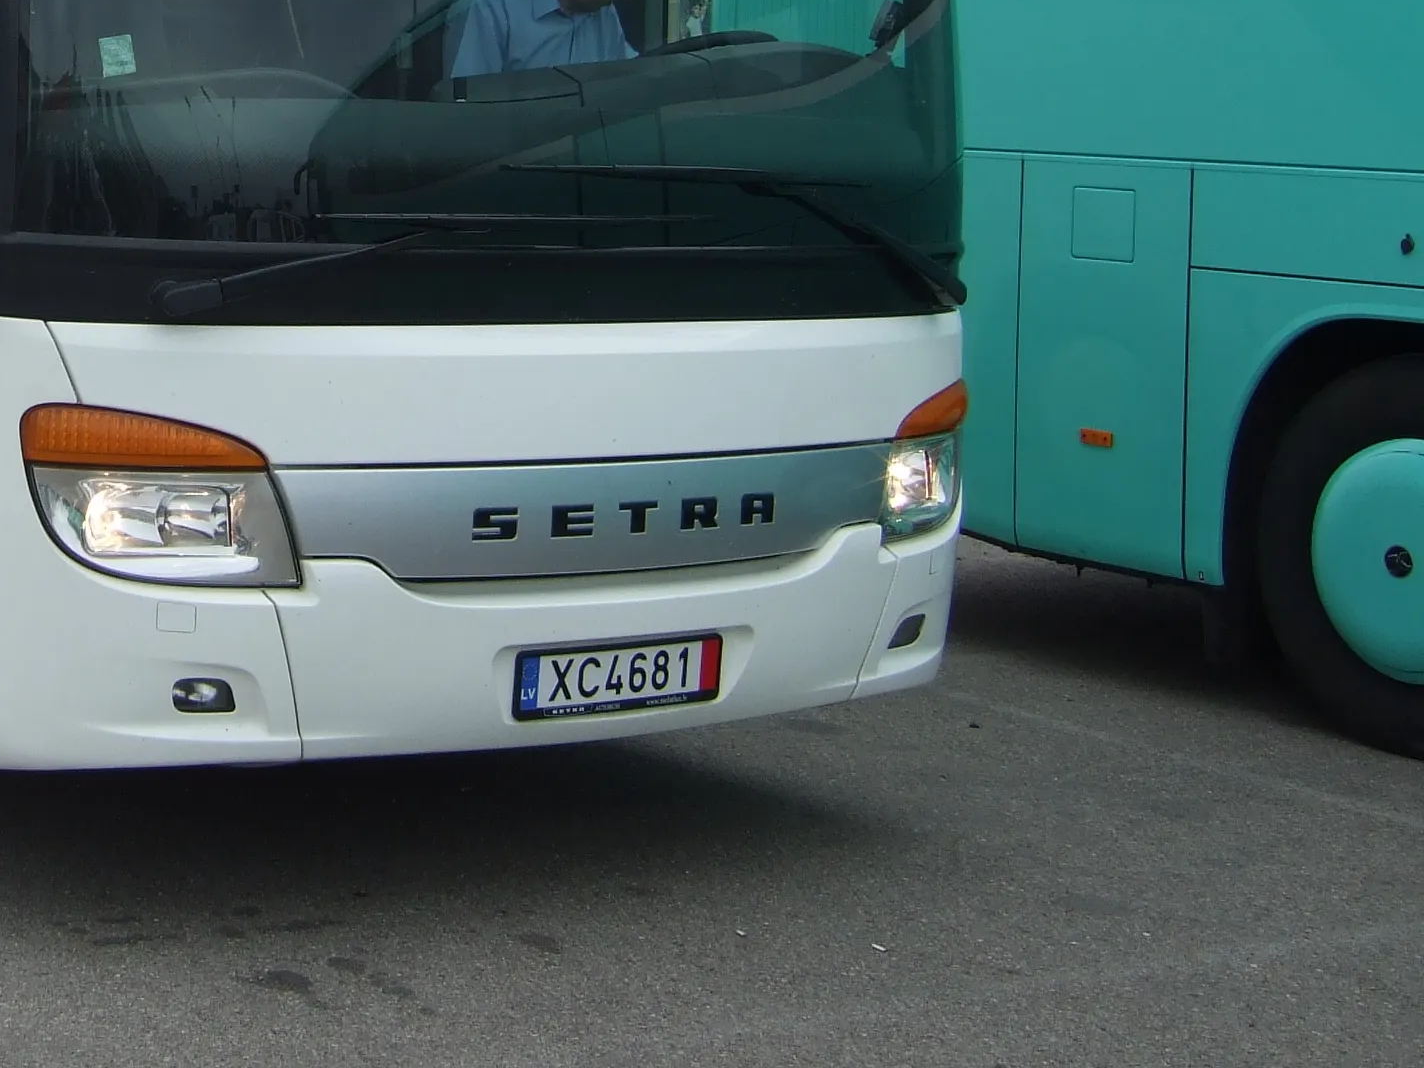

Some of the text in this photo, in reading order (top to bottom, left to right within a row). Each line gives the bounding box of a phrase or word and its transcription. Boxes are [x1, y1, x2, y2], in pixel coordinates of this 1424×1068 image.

[471, 491, 776, 542] SETRA
[520, 687, 536, 701] LV
[548, 646, 689, 702] XC4681
